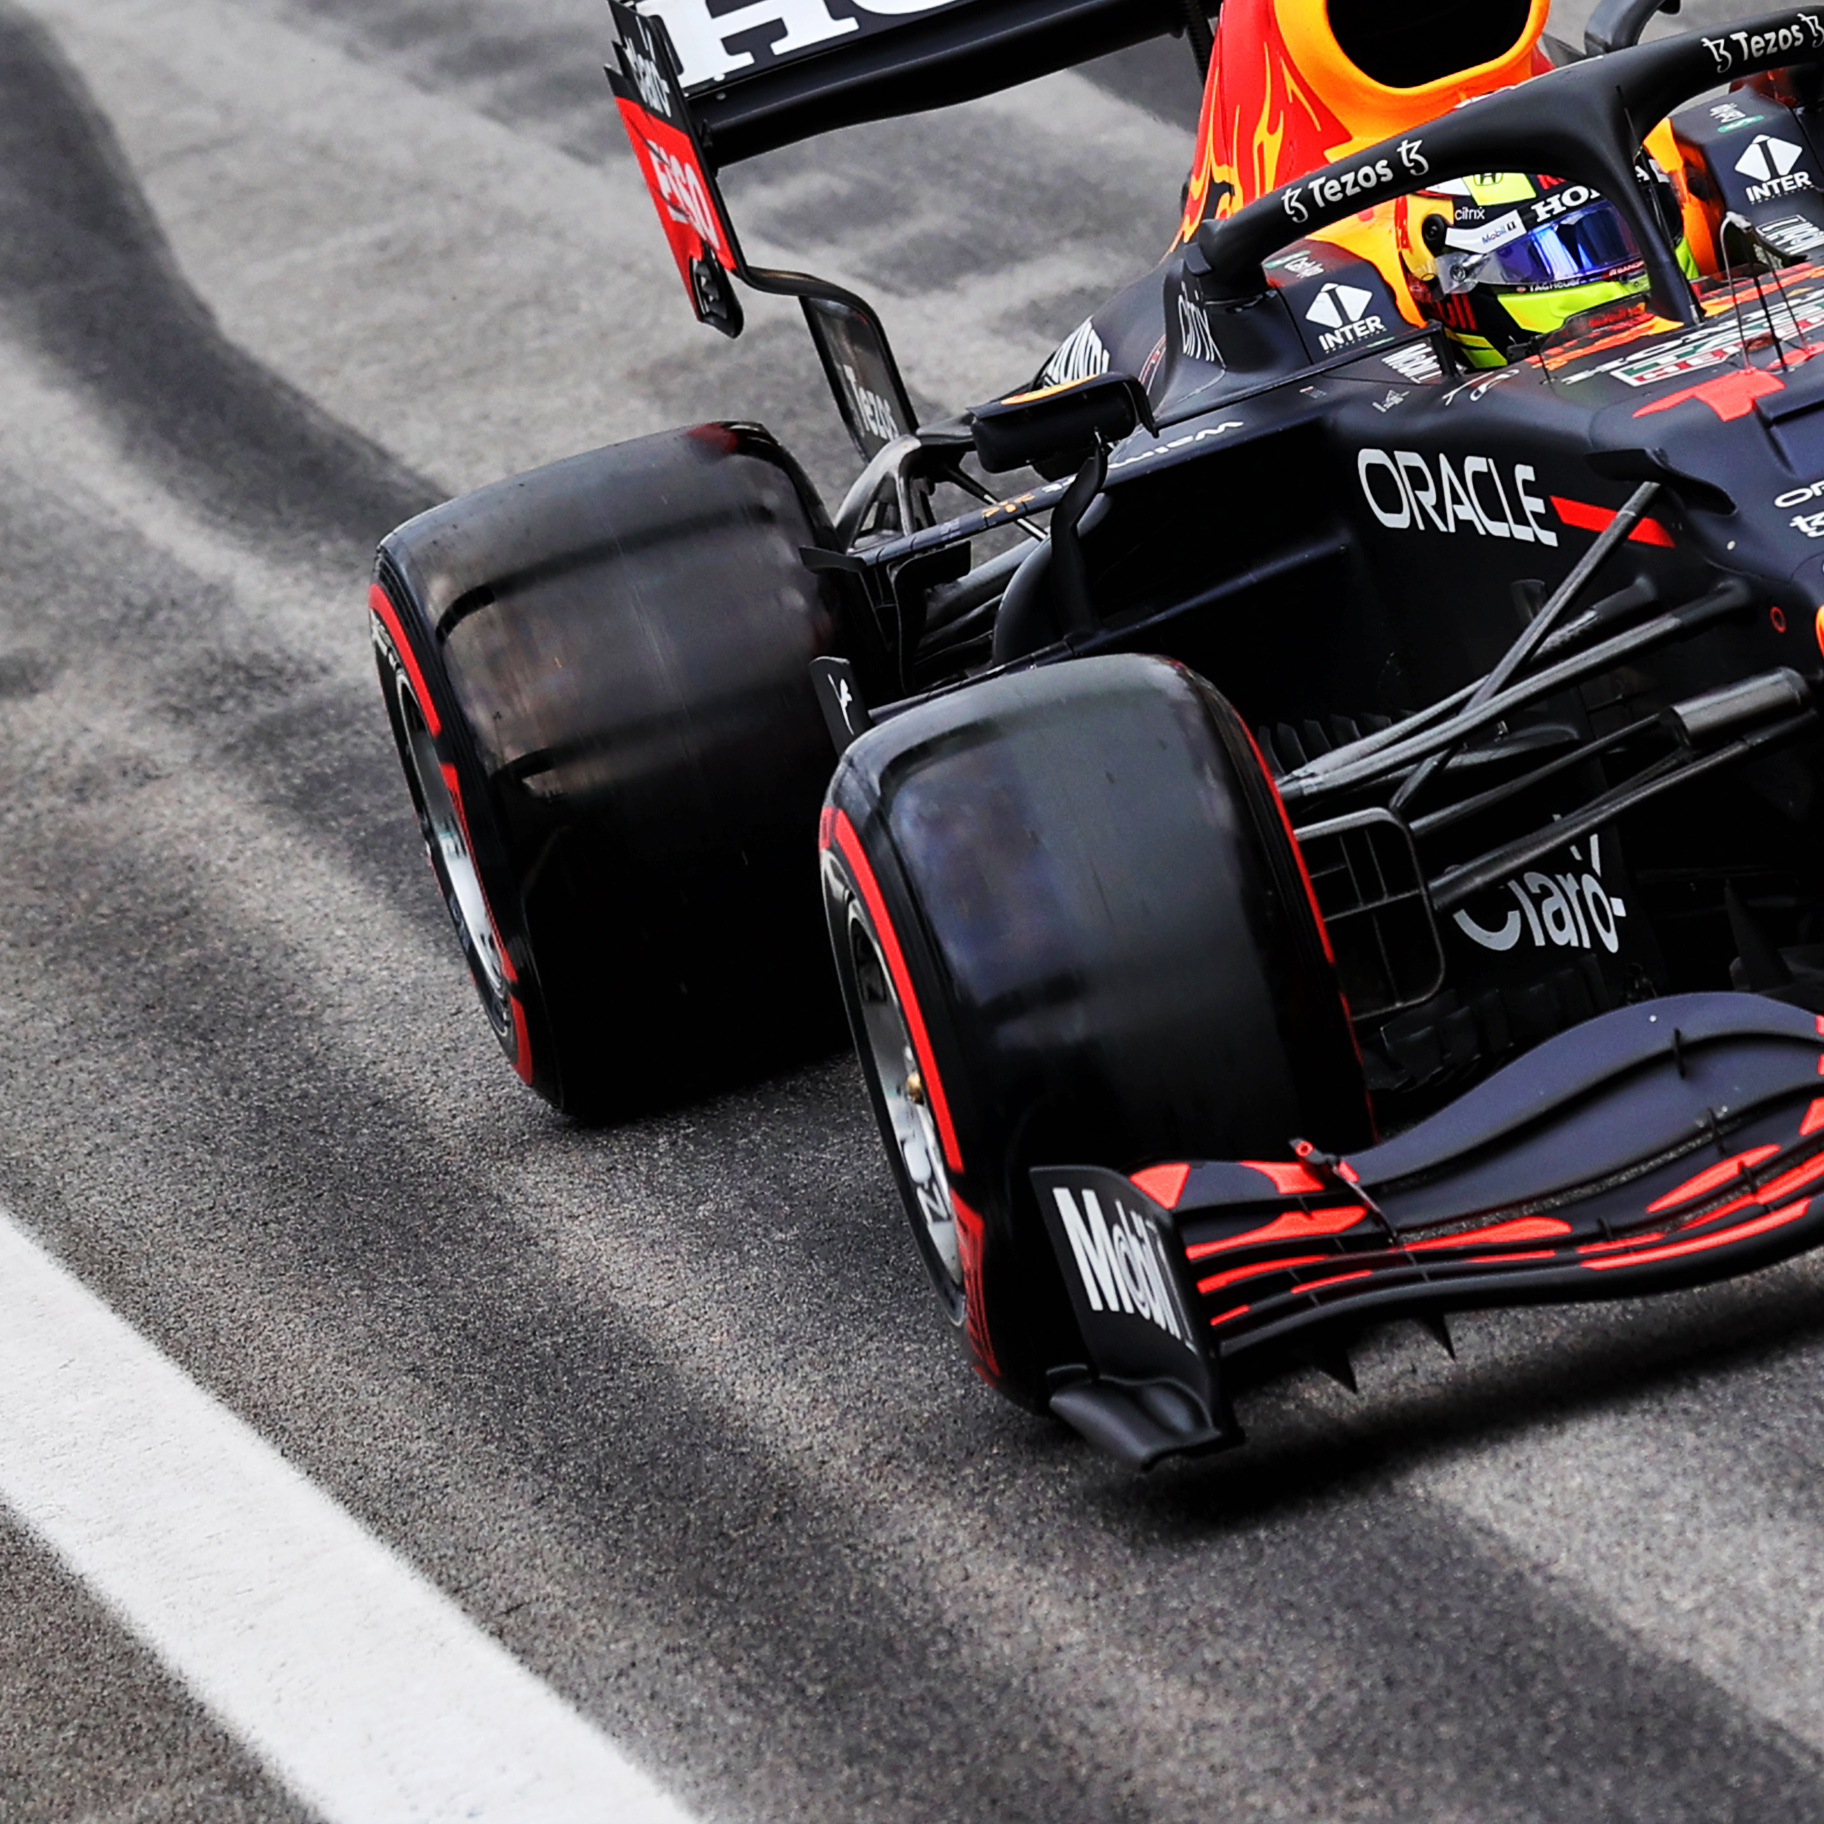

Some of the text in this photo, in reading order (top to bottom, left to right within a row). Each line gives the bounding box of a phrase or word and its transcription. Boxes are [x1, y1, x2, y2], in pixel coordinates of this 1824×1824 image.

[1730, 24, 1805, 63] Tezos
[1307, 158, 1395, 210] Tezos
[1745, 170, 1813, 203] INTER
[1454, 205, 1486, 222] citrix
[1481, 226, 1508, 245] Mobil
[1317, 315, 1386, 352] INTER
[1357, 447, 1559, 548] ORACLE
[1052, 1186, 1182, 1342] Mobil
